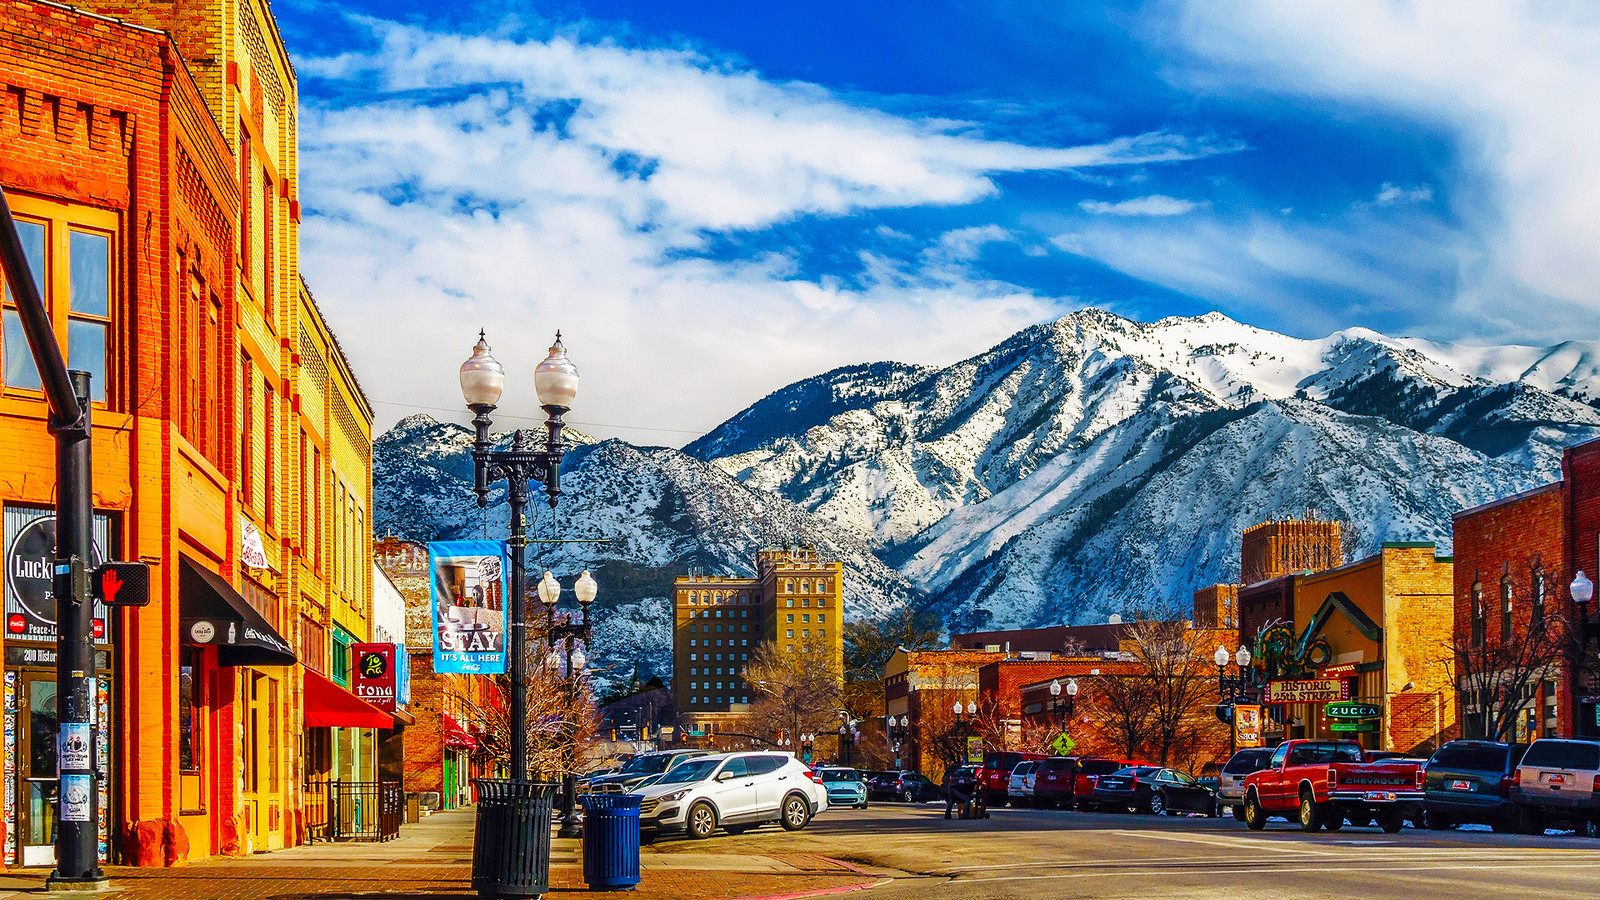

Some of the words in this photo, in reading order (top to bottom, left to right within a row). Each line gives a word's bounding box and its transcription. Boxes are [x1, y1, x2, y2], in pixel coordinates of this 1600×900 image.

[441, 632, 498, 651] STAY
[24, 649, 37, 661] 200
[441, 653, 458, 662] IT'S
[460, 654, 475, 662] ALL
[478, 654, 500, 663] HERE
[1280, 681, 1331, 692] HISTORIC
[1273, 691, 1297, 701] 25th
[1299, 691, 1340, 700] STREET
[1331, 707, 1376, 715] ZUCCA
